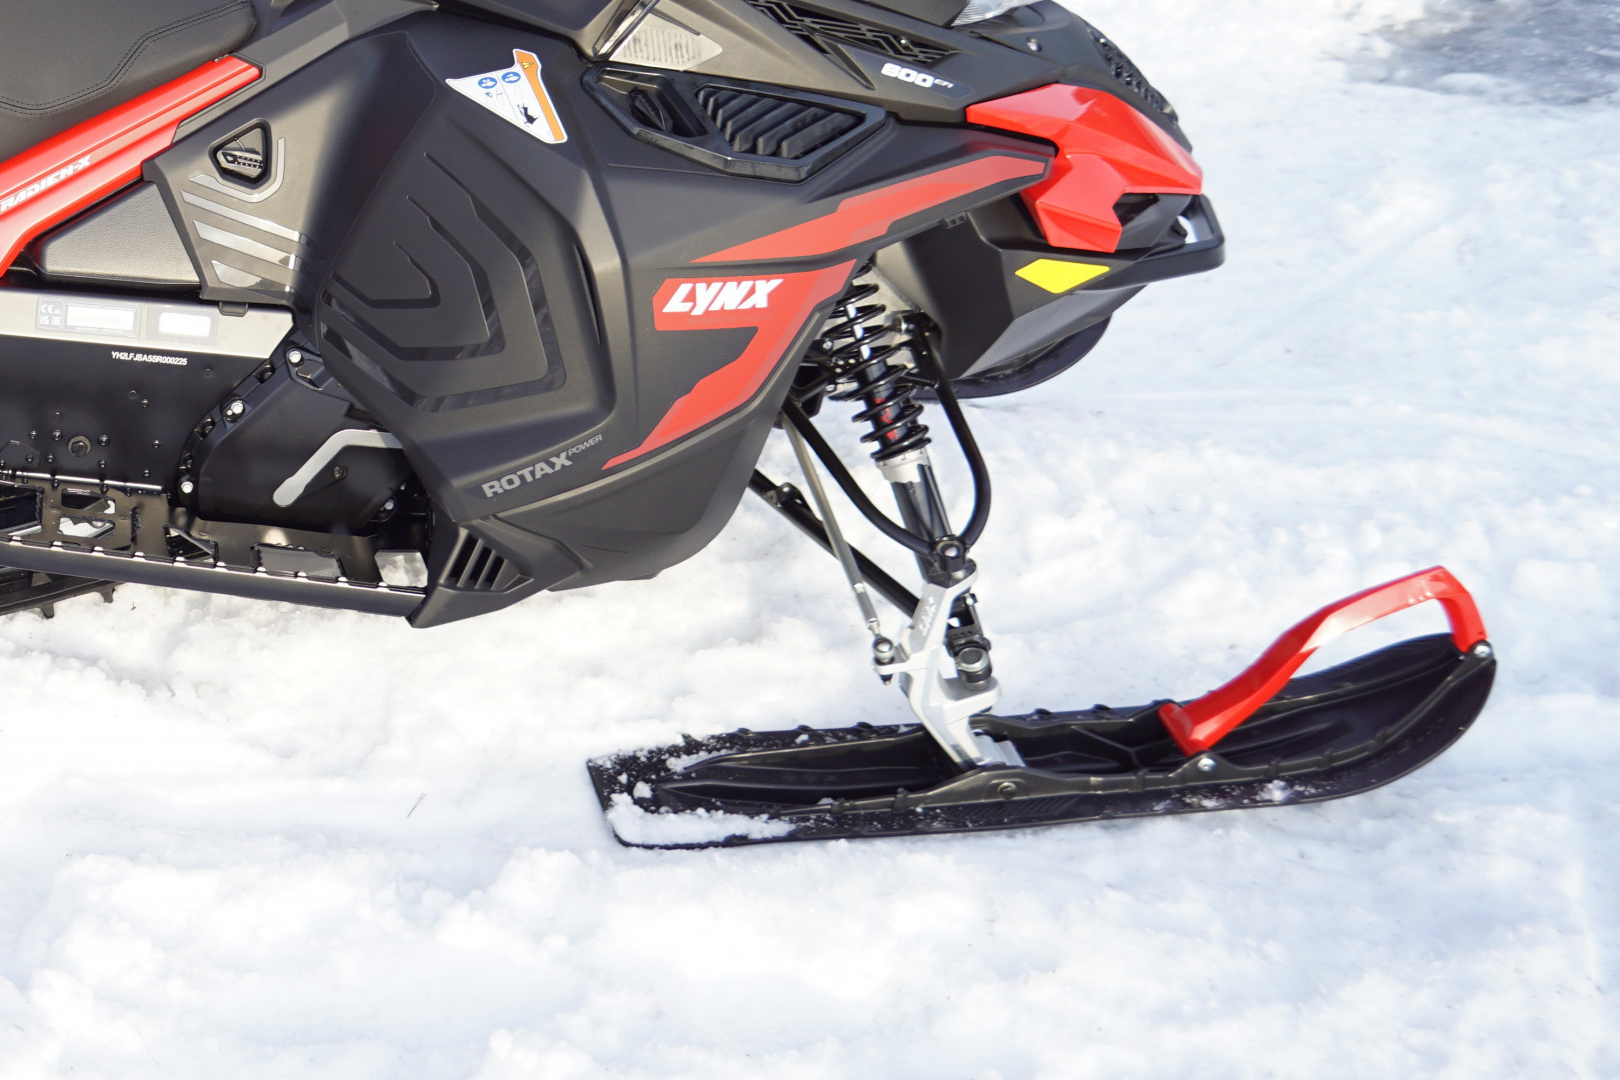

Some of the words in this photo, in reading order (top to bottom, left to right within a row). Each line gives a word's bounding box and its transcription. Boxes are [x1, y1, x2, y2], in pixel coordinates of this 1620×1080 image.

[661, 278, 784, 316] LYNX
[481, 451, 574, 498] ROTAX
[567, 434, 604, 457] POWER
